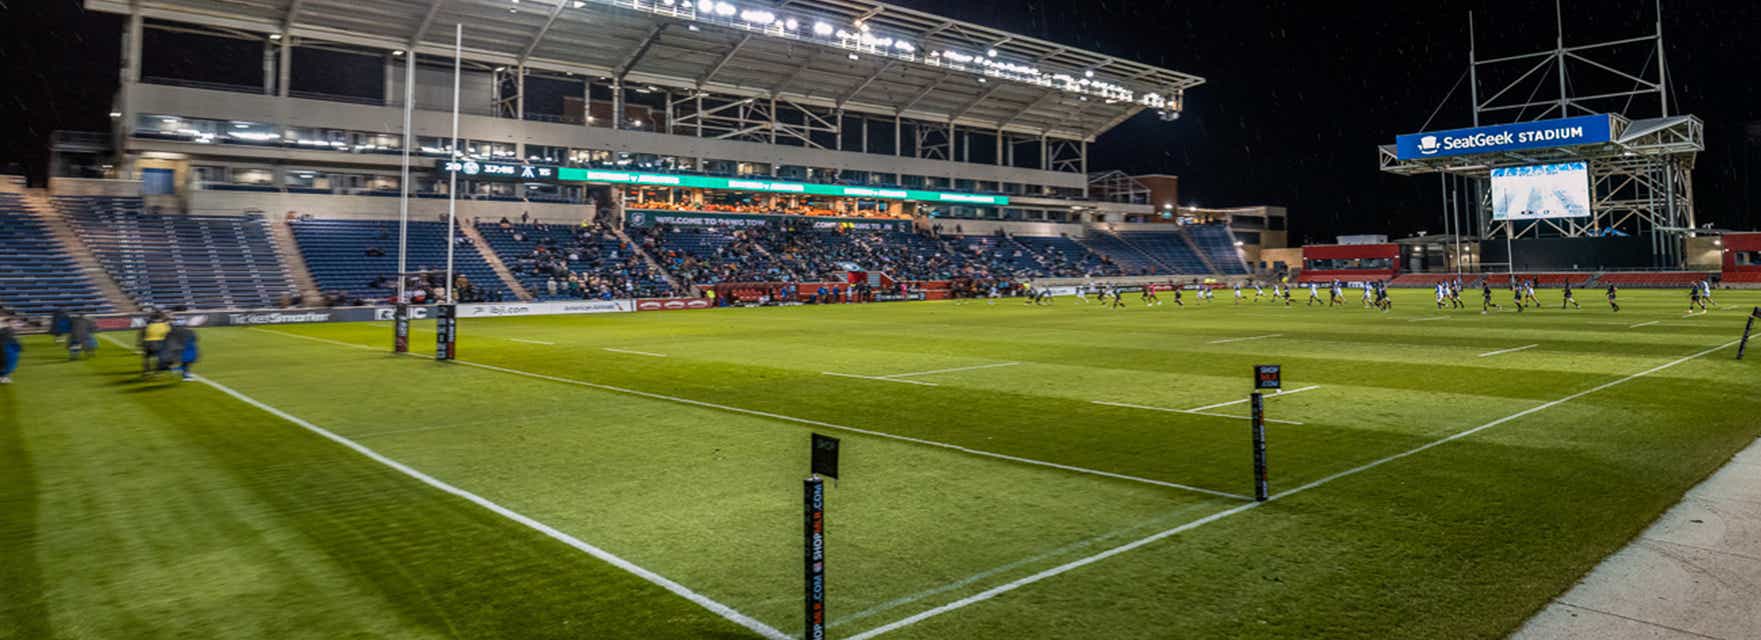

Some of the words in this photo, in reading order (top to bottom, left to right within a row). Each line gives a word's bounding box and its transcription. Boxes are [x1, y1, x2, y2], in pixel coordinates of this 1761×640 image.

[1444, 131, 1514, 151] SeatGeek
[1518, 126, 1583, 142] STADIUM
[655, 216, 702, 225] WELCOME
